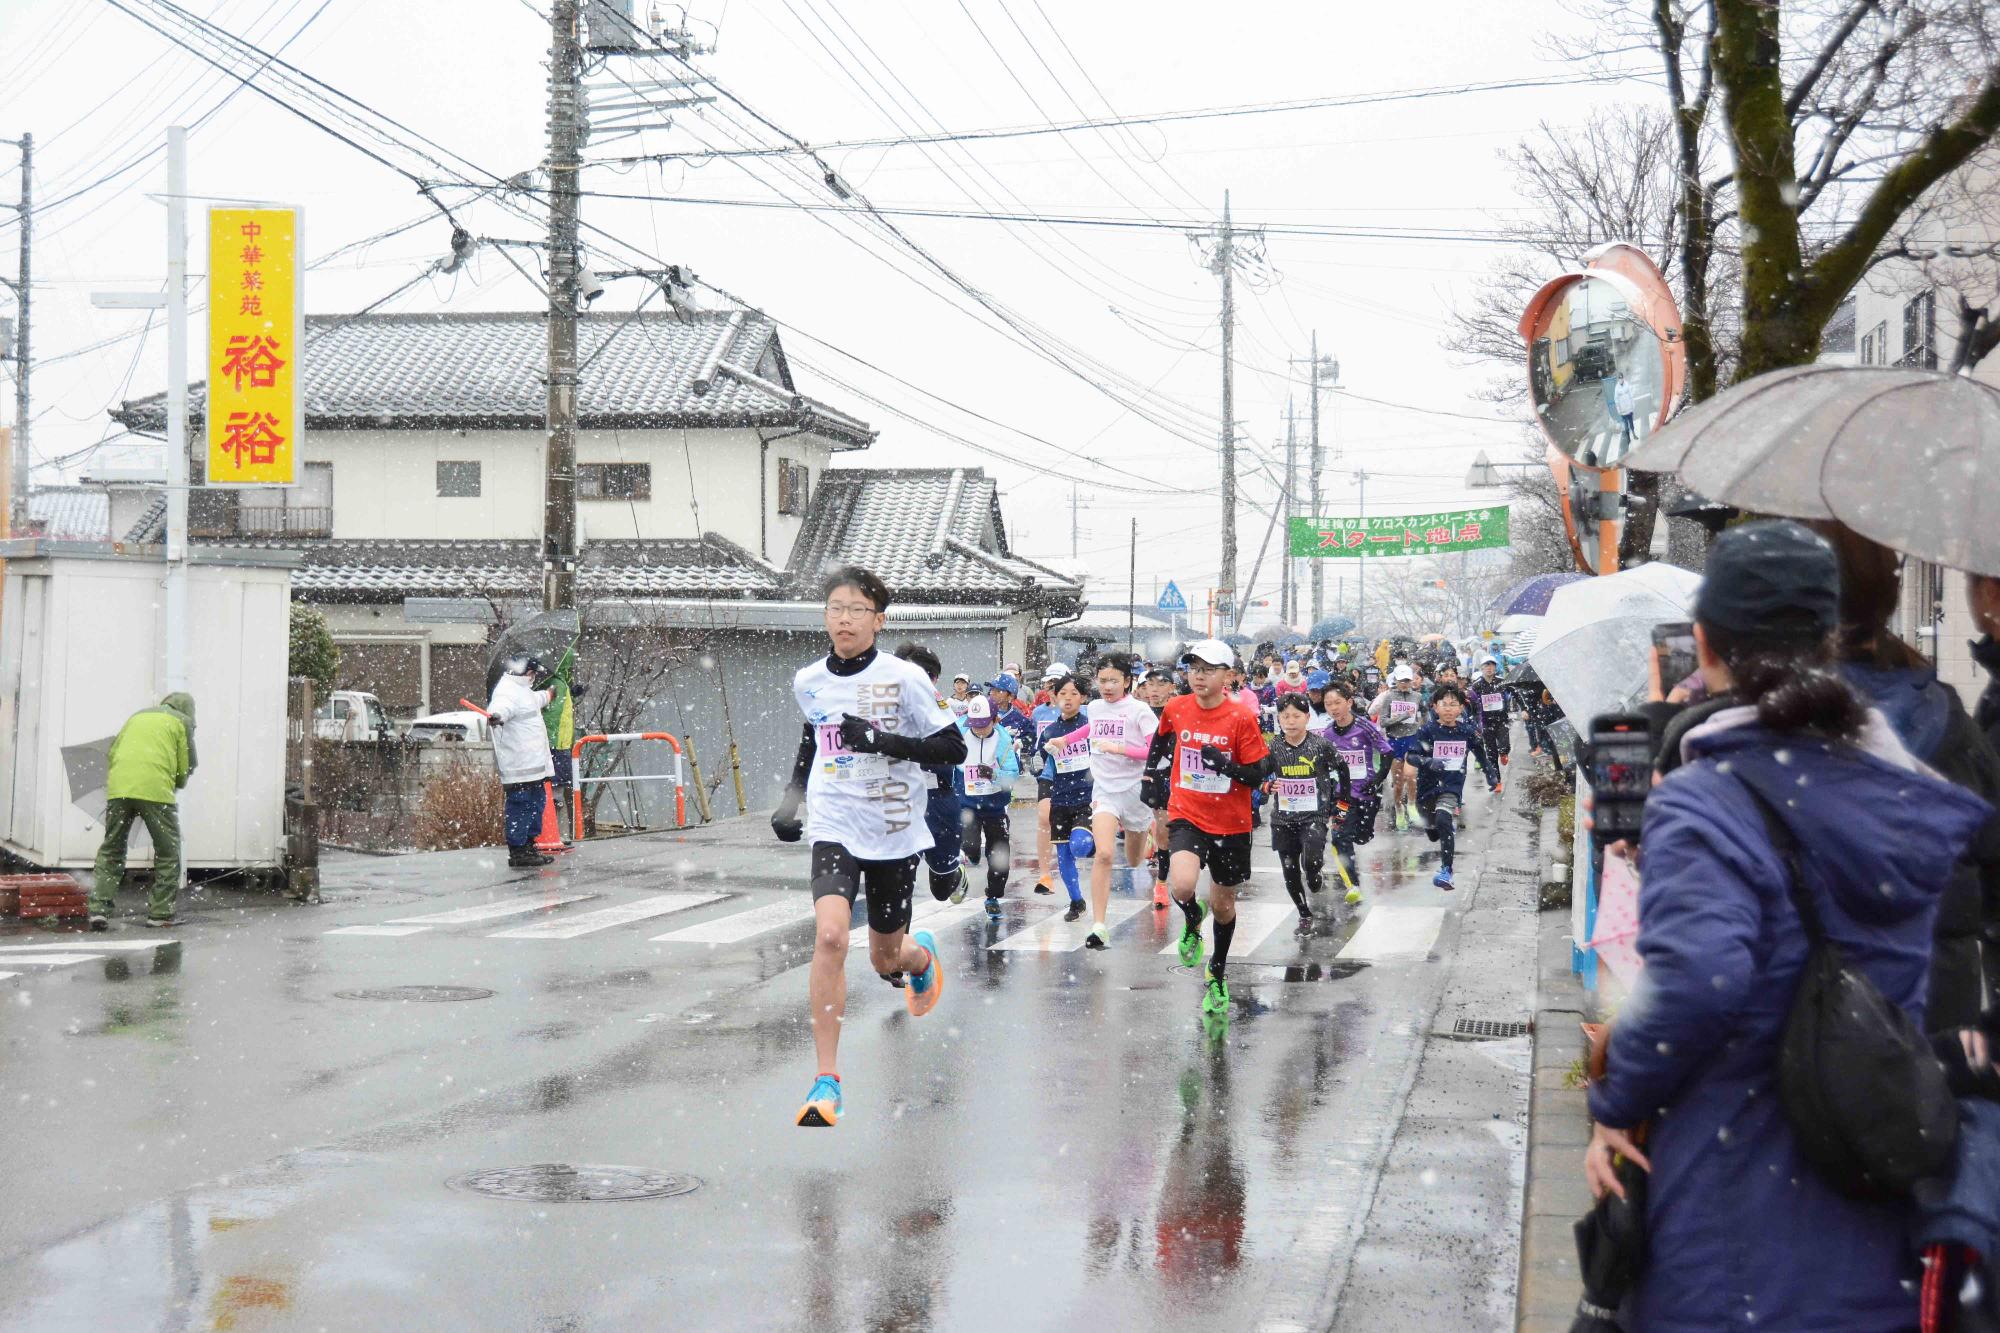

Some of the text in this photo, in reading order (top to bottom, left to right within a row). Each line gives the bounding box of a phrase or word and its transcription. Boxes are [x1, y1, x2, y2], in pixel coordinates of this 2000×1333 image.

[239, 221, 264, 316] 中華菜苑
[220, 335, 286, 470] 裕裕
[1317, 523, 1483, 548] スタート地点
[1281, 765, 1310, 776] PUMA
[1282, 784, 1306, 795] 1022
